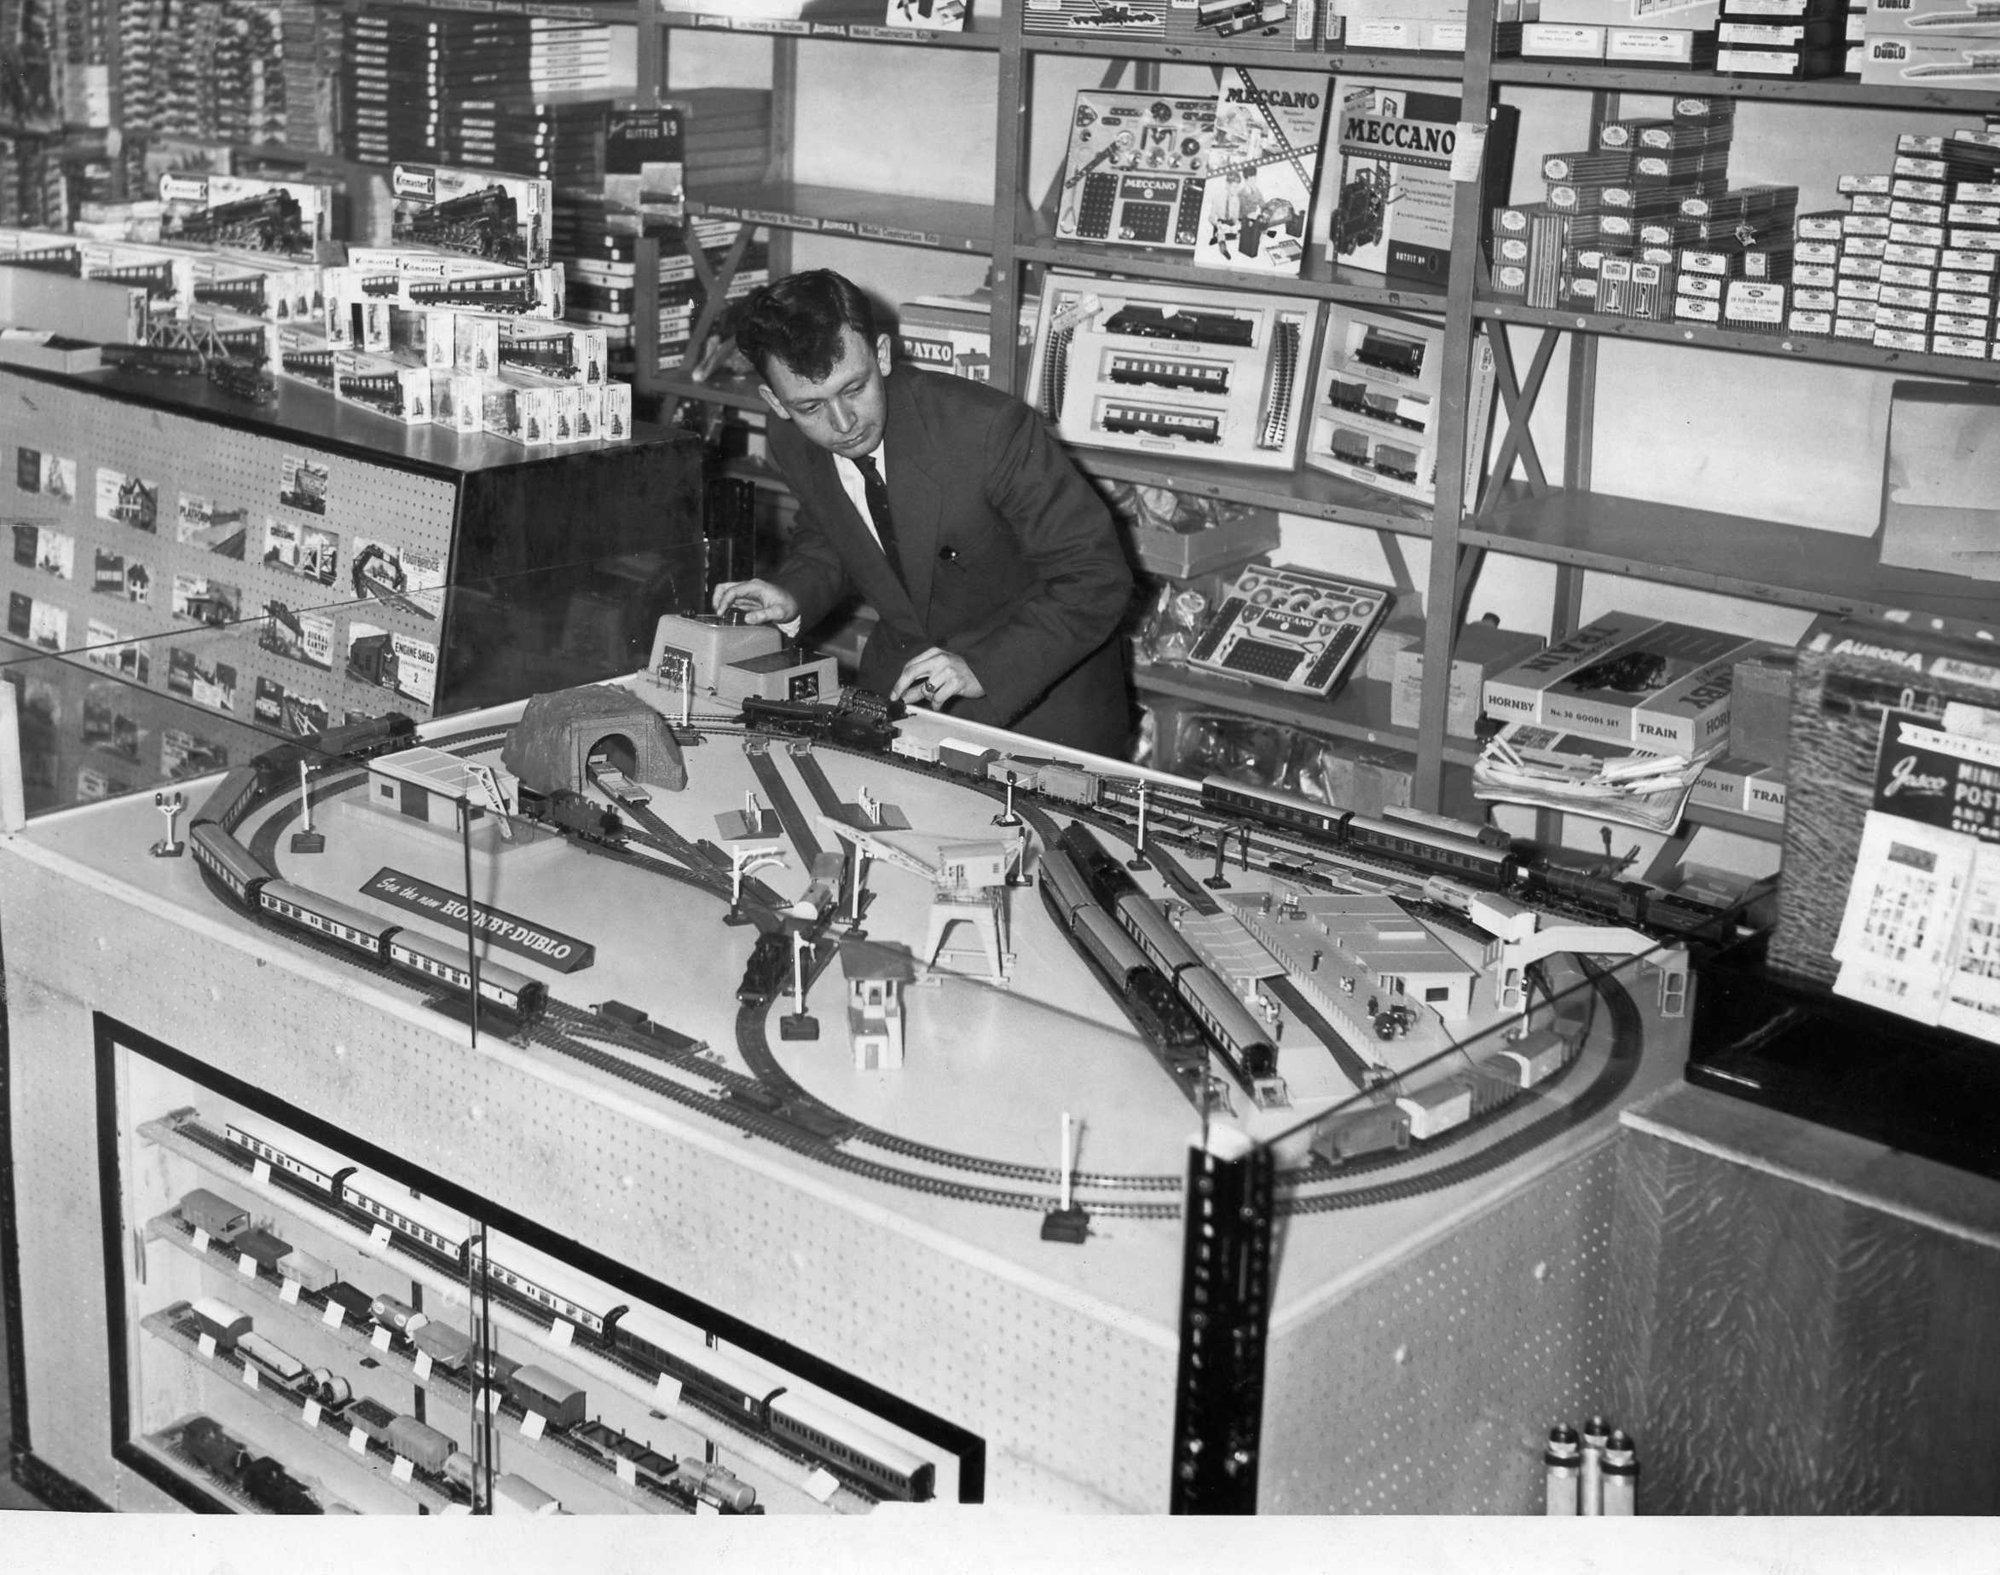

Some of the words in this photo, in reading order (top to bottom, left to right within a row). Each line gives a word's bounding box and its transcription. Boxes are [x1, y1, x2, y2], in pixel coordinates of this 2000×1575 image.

[1225, 88, 1320, 109] MECCANO
[1344, 118, 1456, 155] MECCANO
[1125, 179, 1176, 190] MECCANO
[904, 341, 951, 362] BAYKO
[1265, 612, 1314, 627] MECCANO
[1488, 695, 1535, 712] HORNBY
[1576, 713, 1603, 725] GOODS
[1607, 719, 1619, 728] SET
[1638, 723, 1678, 740] TRAIN
[1721, 783, 1734, 793] SET
[376, 877, 400, 893] See
[399, 886, 419, 900] the
